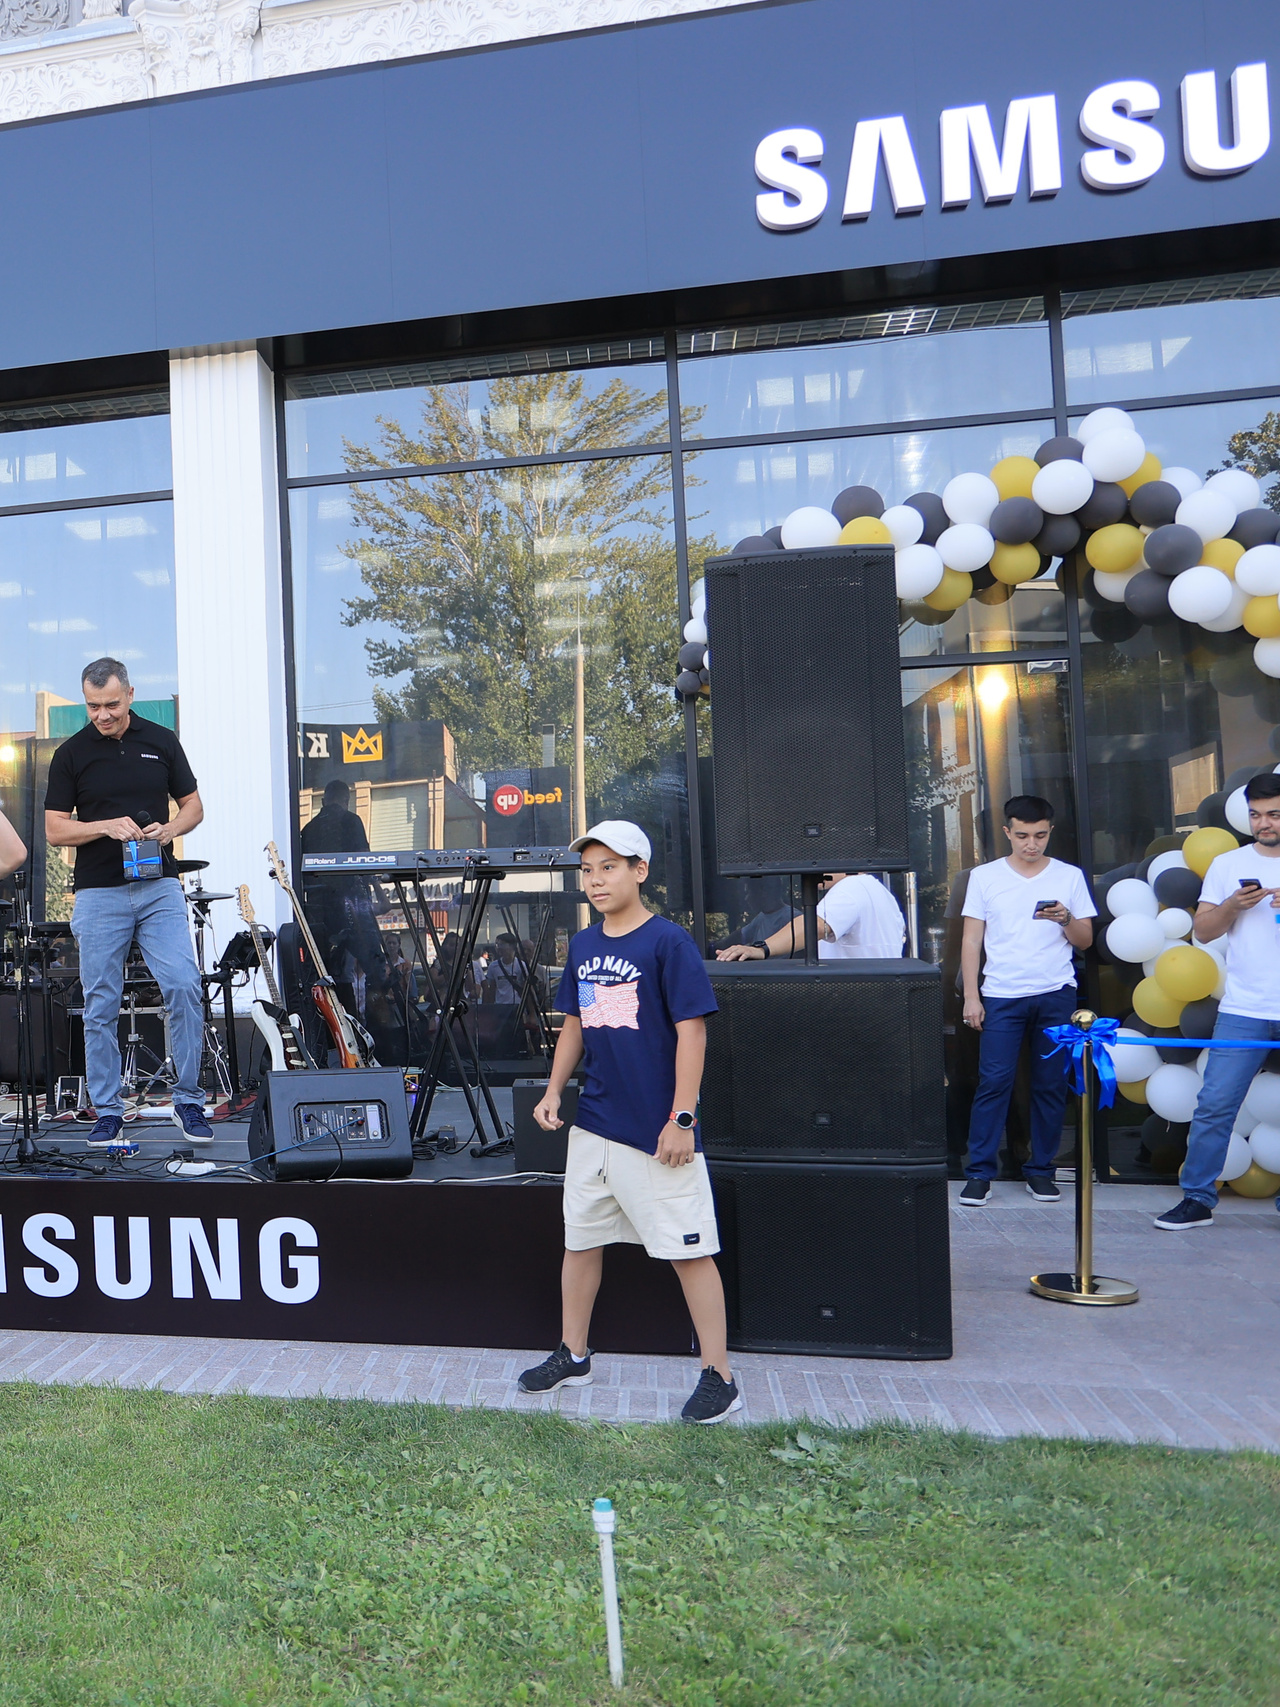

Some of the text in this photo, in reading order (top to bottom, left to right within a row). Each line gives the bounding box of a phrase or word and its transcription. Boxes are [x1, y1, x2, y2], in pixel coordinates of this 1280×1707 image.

[754, 61, 1271, 231] SAMSU
[314, 857, 336, 865] Roland
[578, 955, 642, 982] OLD NAVY
